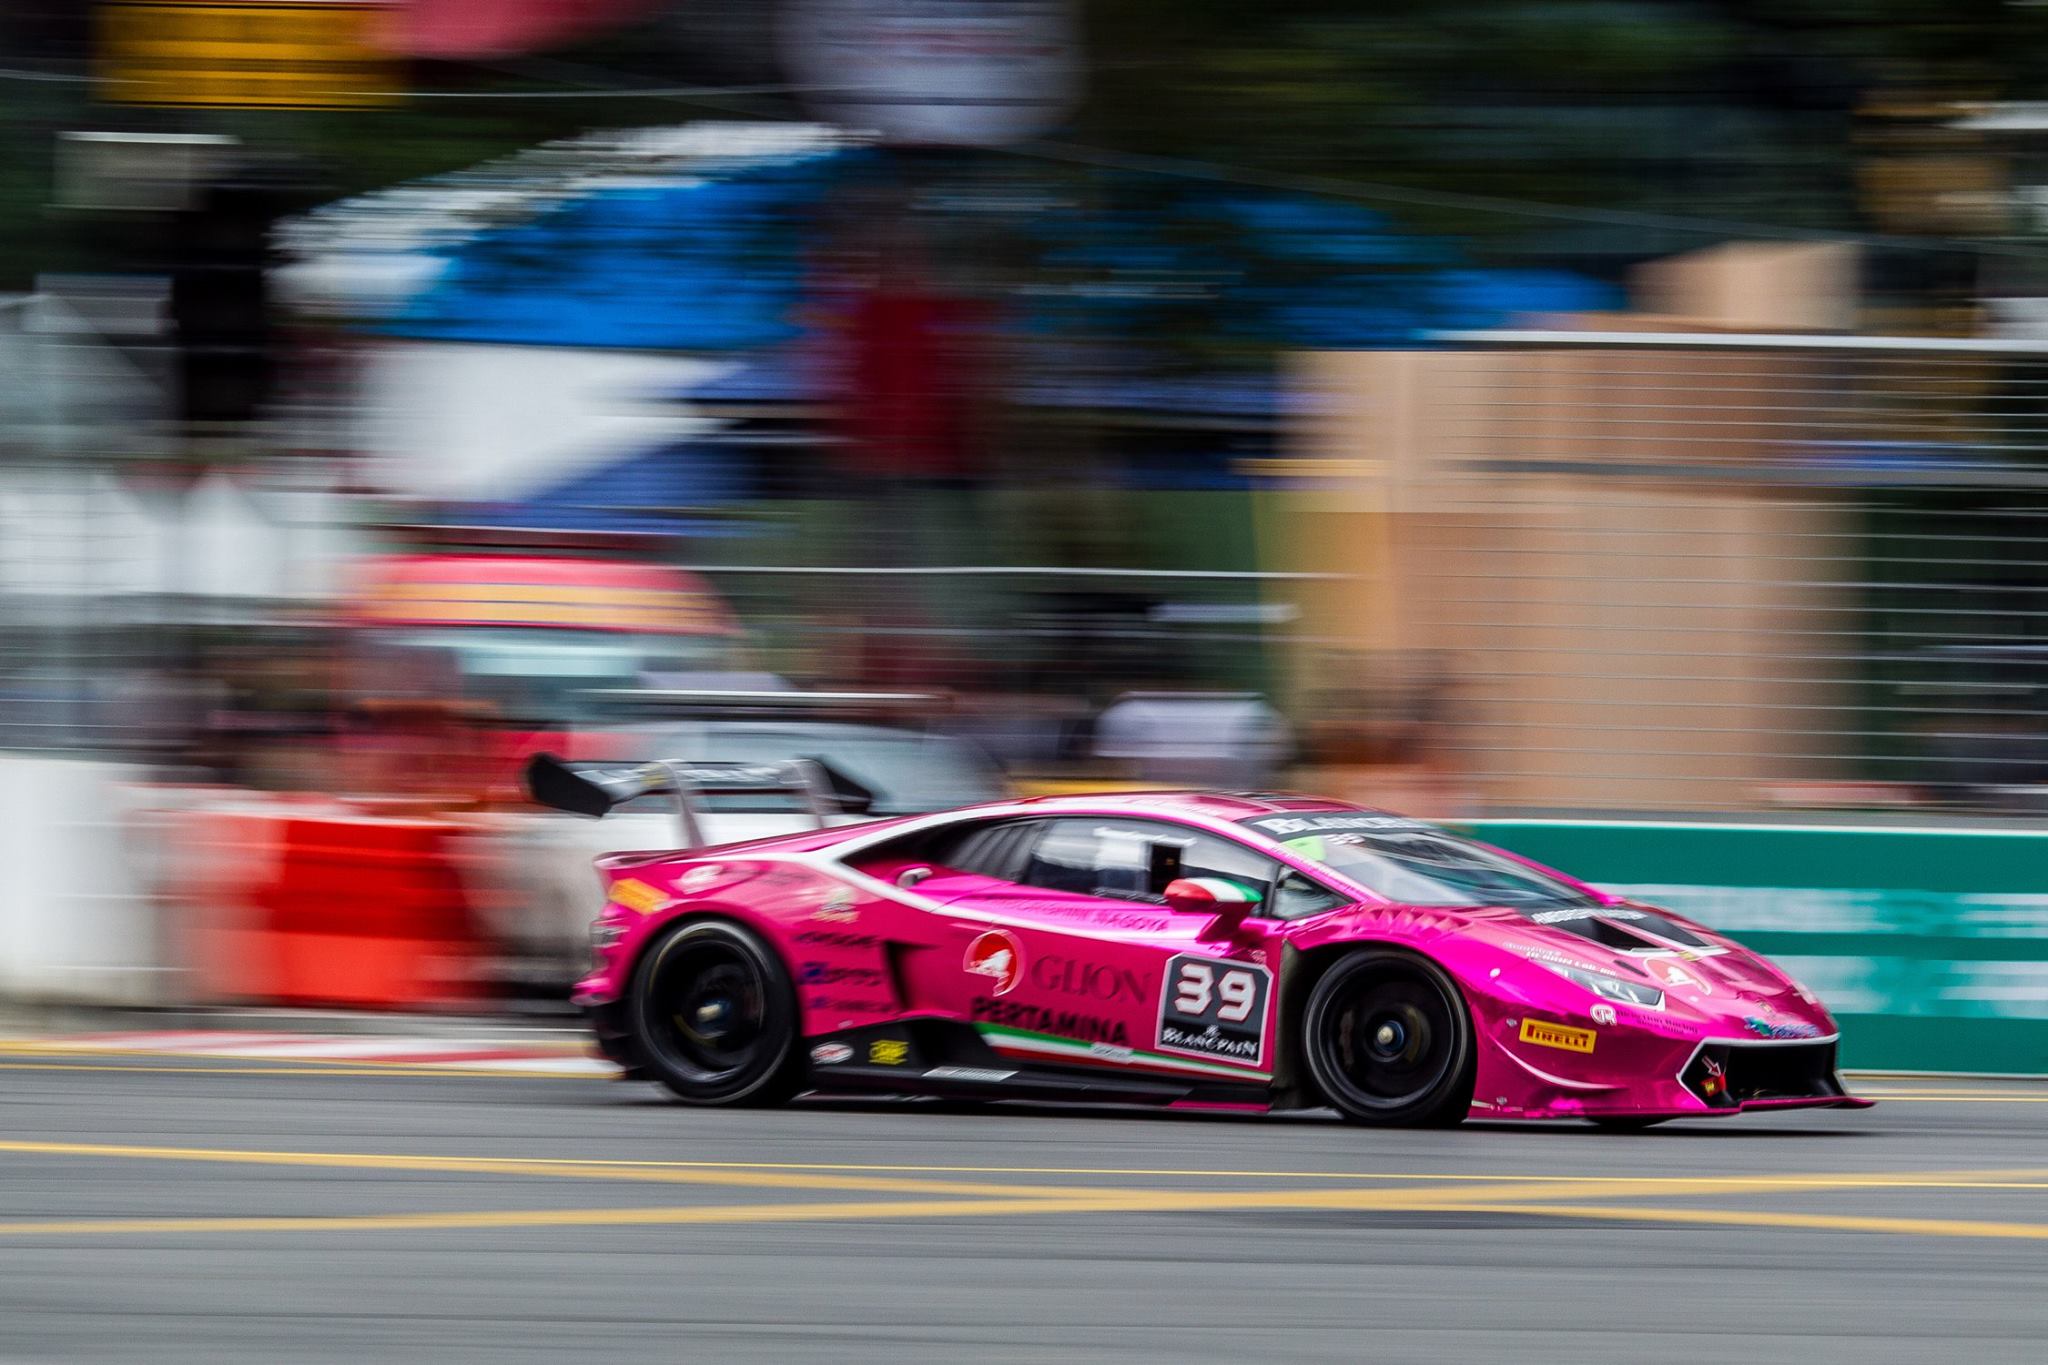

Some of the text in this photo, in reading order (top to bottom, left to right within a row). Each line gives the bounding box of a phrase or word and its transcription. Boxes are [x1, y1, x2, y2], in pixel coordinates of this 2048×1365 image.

[1030, 955, 1153, 1005] GLION
[1174, 963, 1257, 1022] 39
[971, 996, 1131, 1046] PERTAMINA
[1162, 1027, 1258, 1057] BLANCPAIN
[1526, 1024, 1590, 1048] PIRELLI
